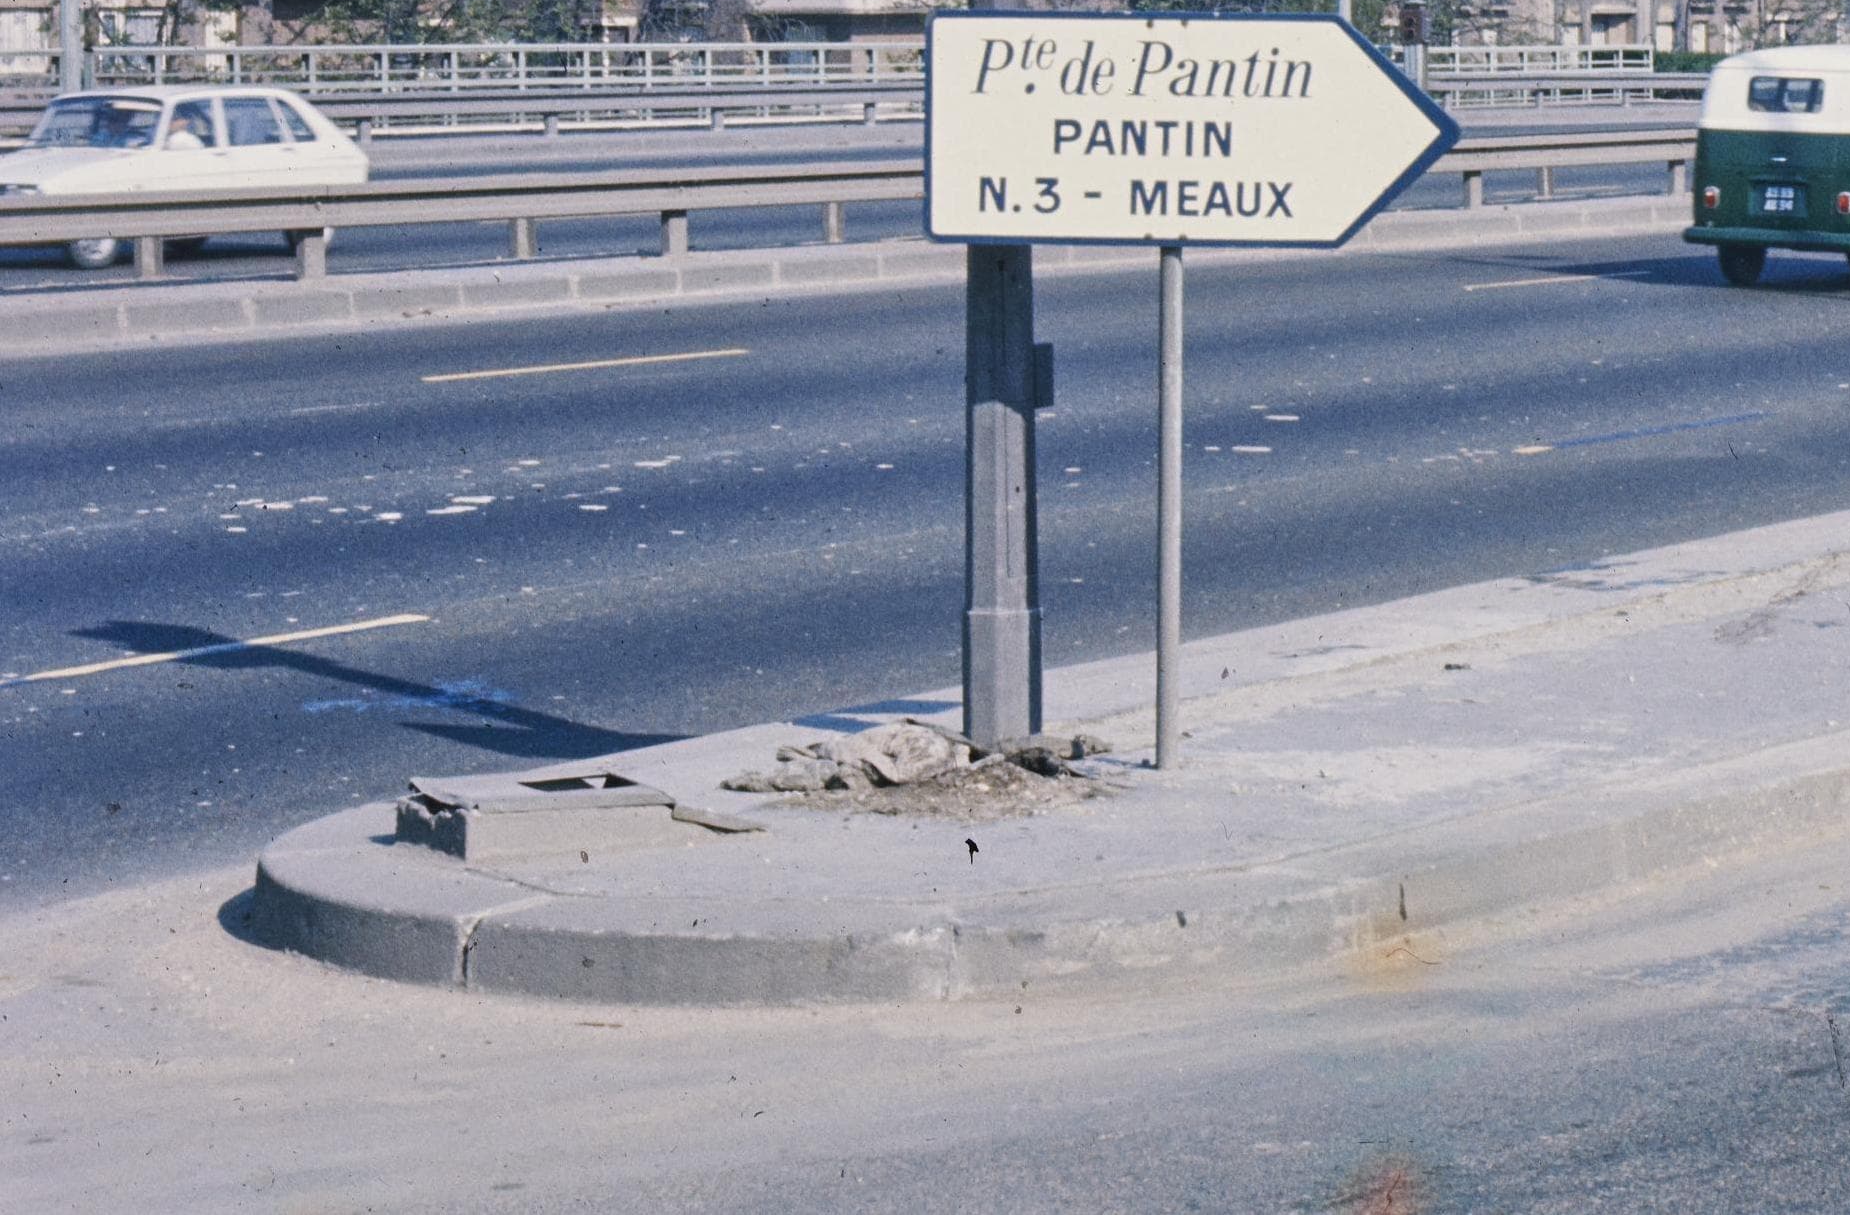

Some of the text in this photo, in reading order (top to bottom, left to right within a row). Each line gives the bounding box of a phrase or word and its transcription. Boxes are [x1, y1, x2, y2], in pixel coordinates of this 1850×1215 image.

[1059, 40, 1116, 96] de
[1125, 40, 1313, 98] Pantin
[1053, 119, 1233, 158] PANTIN
[1129, 179, 1294, 218] MEAUX
